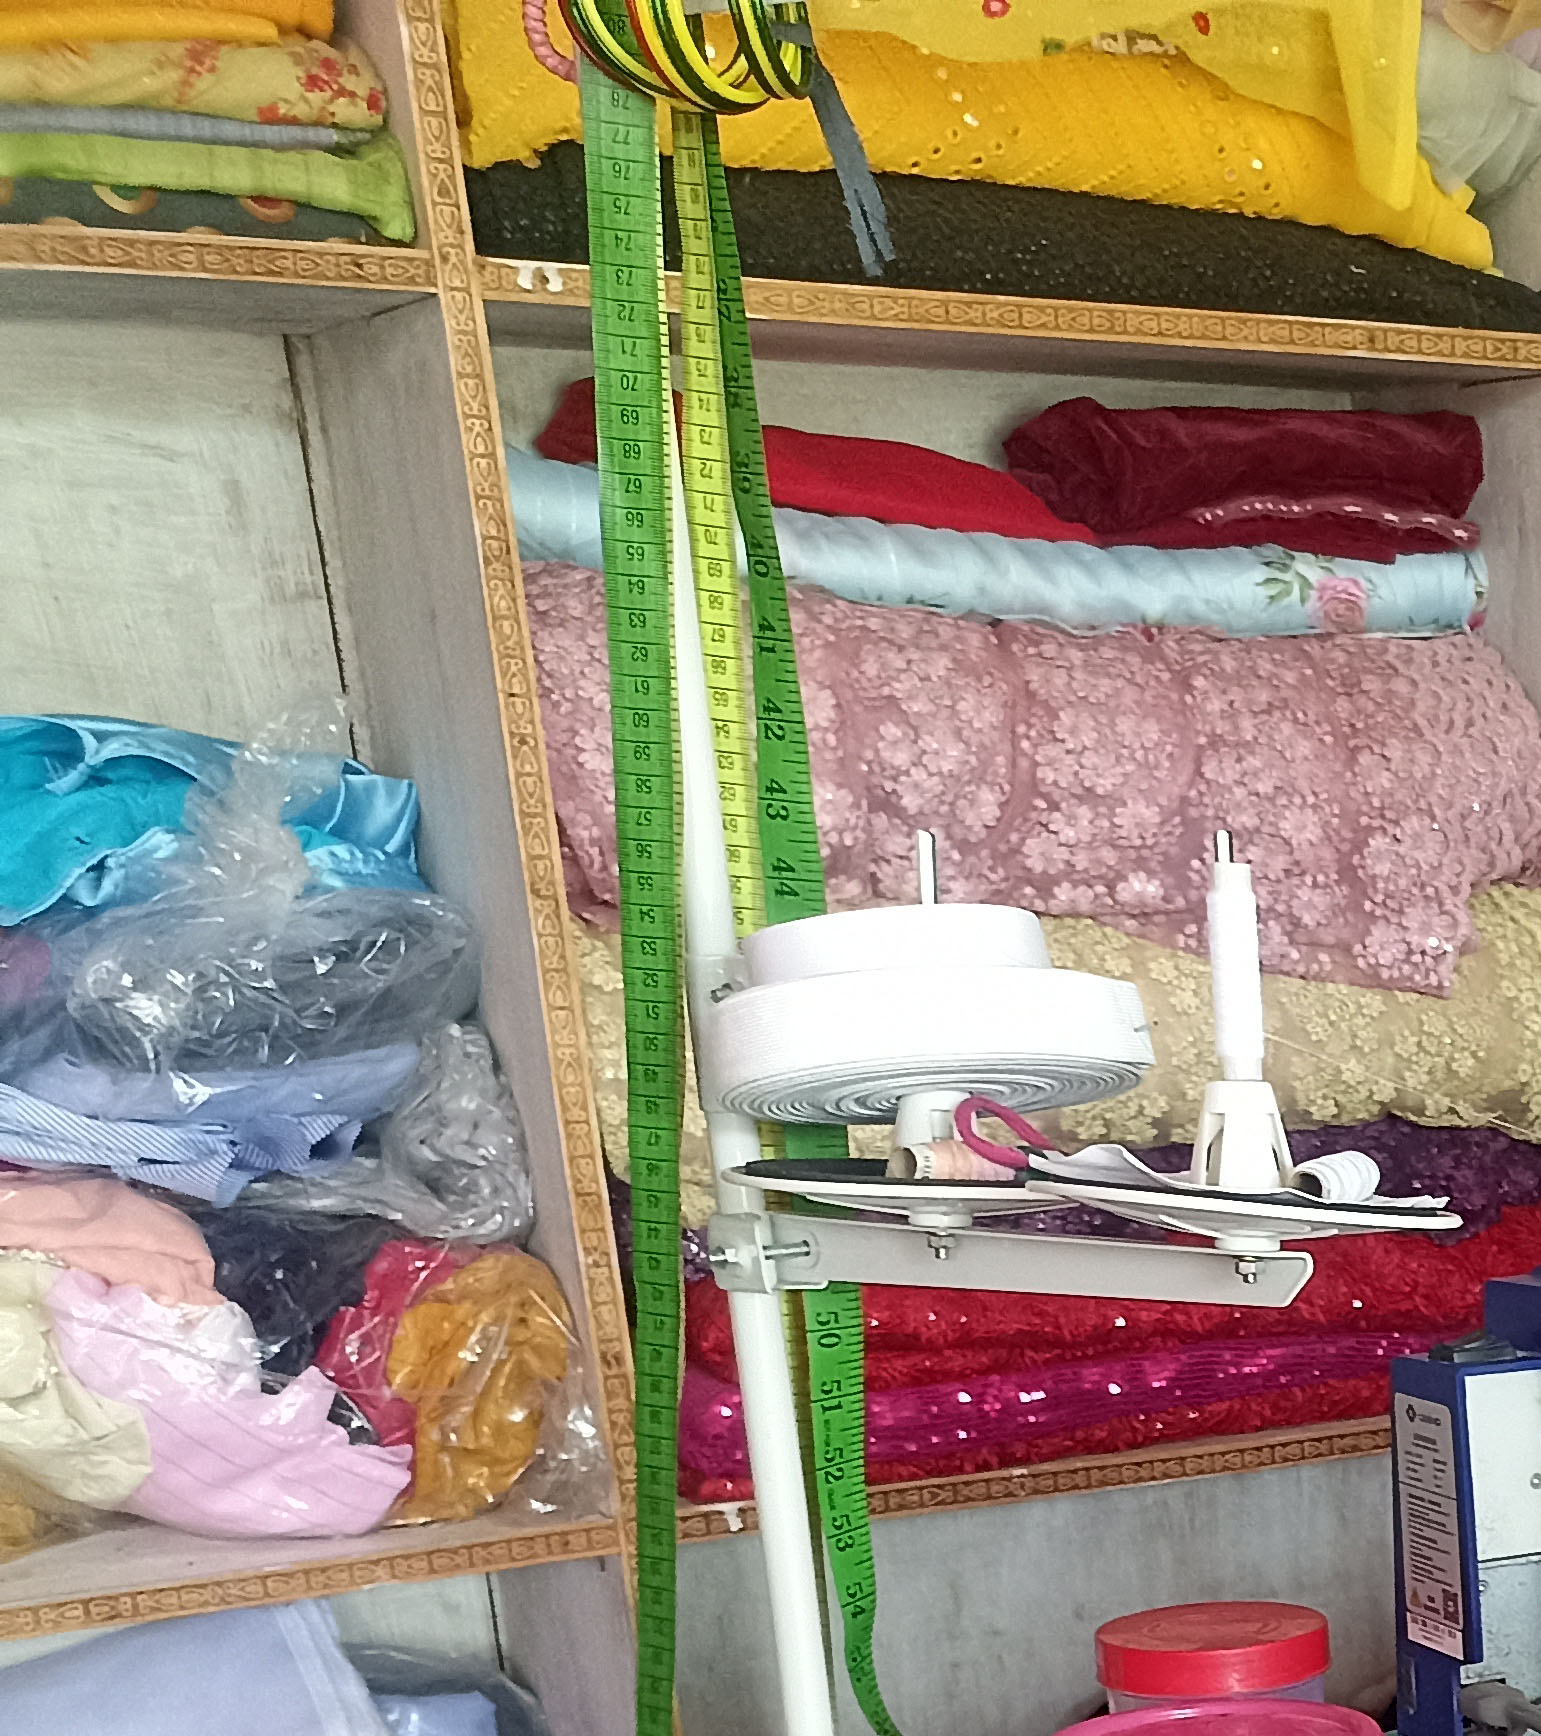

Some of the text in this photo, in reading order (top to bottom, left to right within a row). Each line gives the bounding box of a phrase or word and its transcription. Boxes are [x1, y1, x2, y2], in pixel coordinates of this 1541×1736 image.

[612, 92, 630, 110] 78
[612, 127, 630, 144] 77
[613, 162, 631, 180] 76
[614, 198, 631, 215] 75
[615, 233, 633, 251] 74
[616, 268, 634, 285] 73
[618, 302, 636, 320] 72
[619, 337, 637, 354] 71
[621, 373, 639, 391] 70
[622, 407, 640, 425] 69
[699, 429, 712, 445] 73
[623, 441, 641, 459] 68
[700, 461, 714, 478] 72
[625, 475, 643, 492] 67
[702, 496, 715, 512] 71
[626, 510, 644, 527] 66
[704, 528, 719, 545] 70
[627, 544, 645, 561] 65
[750, 533, 771, 578] 40
[628, 578, 646, 595] 64
[629, 611, 647, 628] 63
[711, 627, 725, 643] 67
[757, 615, 778, 655] 41
[631, 645, 649, 662] 62
[633, 678, 649, 694] 61
[632, 712, 649, 728] 60
[762, 695, 787, 742] 42
[715, 723, 731, 739] 64
[634, 745, 651, 760] 59
[635, 778, 652, 793] 58
[764, 776, 791, 822] 43
[636, 810, 652, 825] 57
[636, 843, 653, 858] 56
[637, 875, 654, 891] 55
[770, 856, 802, 898] 44
[640, 908, 656, 924] 54
[641, 940, 657, 956] 53
[643, 973, 659, 988] 52
[645, 1005, 660, 1019] 51
[815, 1311, 842, 1349] 50
[820, 1378, 844, 1416] 51
[823, 1446, 845, 1485] 52
[831, 1512, 856, 1553] 53
[845, 1581, 867, 1619] 54
